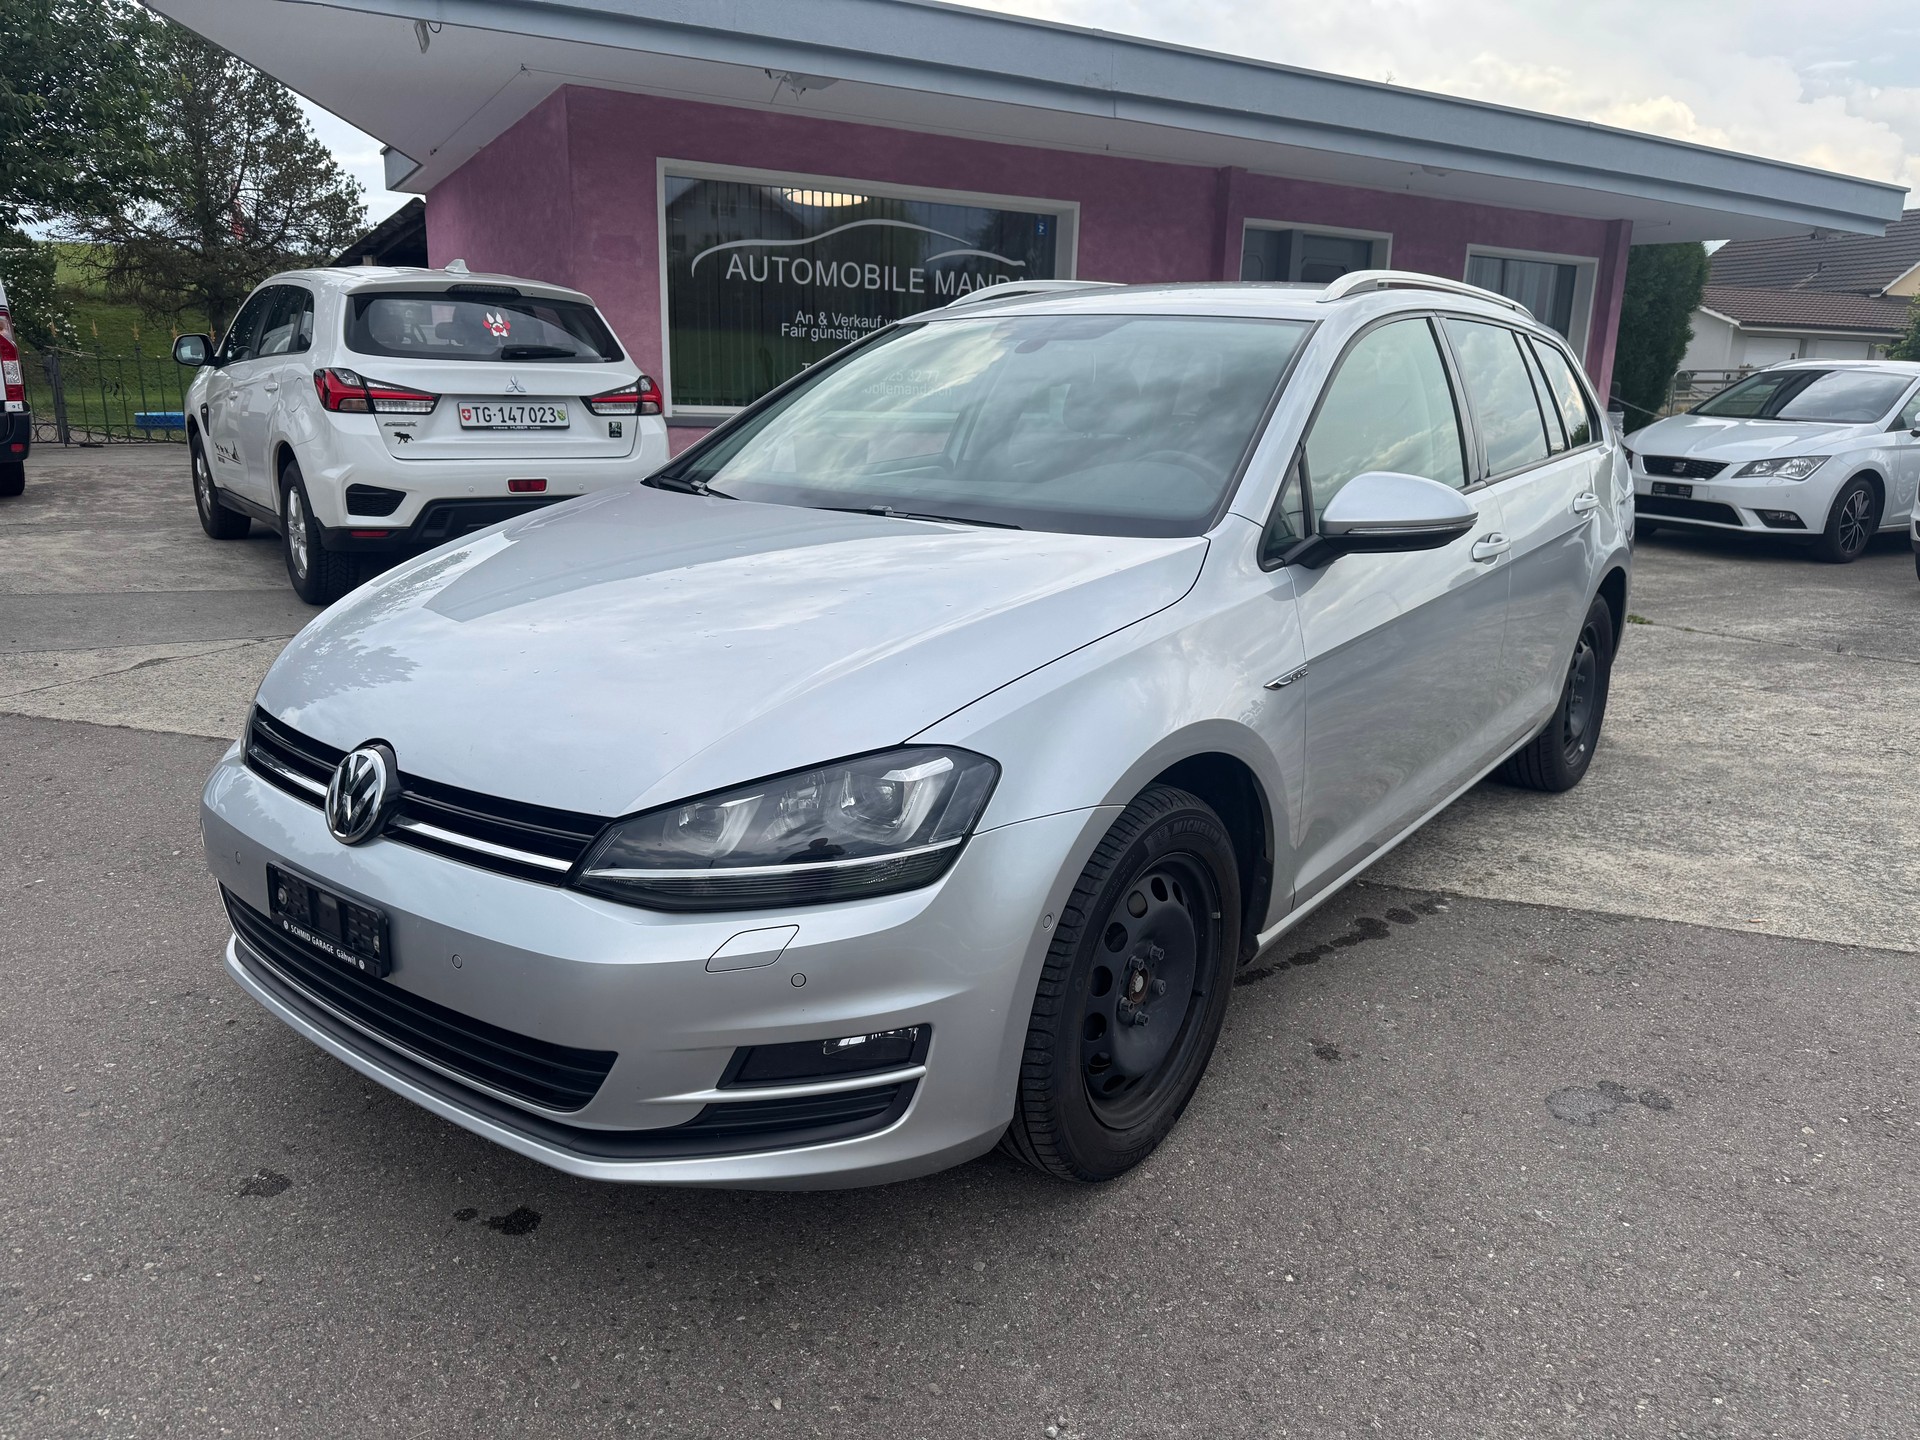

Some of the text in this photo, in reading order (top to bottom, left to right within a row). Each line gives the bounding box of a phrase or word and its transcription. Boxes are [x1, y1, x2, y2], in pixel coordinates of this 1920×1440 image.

[725, 253, 1025, 296] AUTOMOBILE MAN
[795, 310, 814, 325] An
[818, 311, 828, 326] &
[832, 312, 882, 329] Verkauf
[781, 323, 807, 338] Fair
[811, 326, 859, 343] günstig
[1172, 820, 1221, 843] MICHELIN
[290, 924, 311, 942] SCHMID
[312, 936, 334, 955] GARAGE
